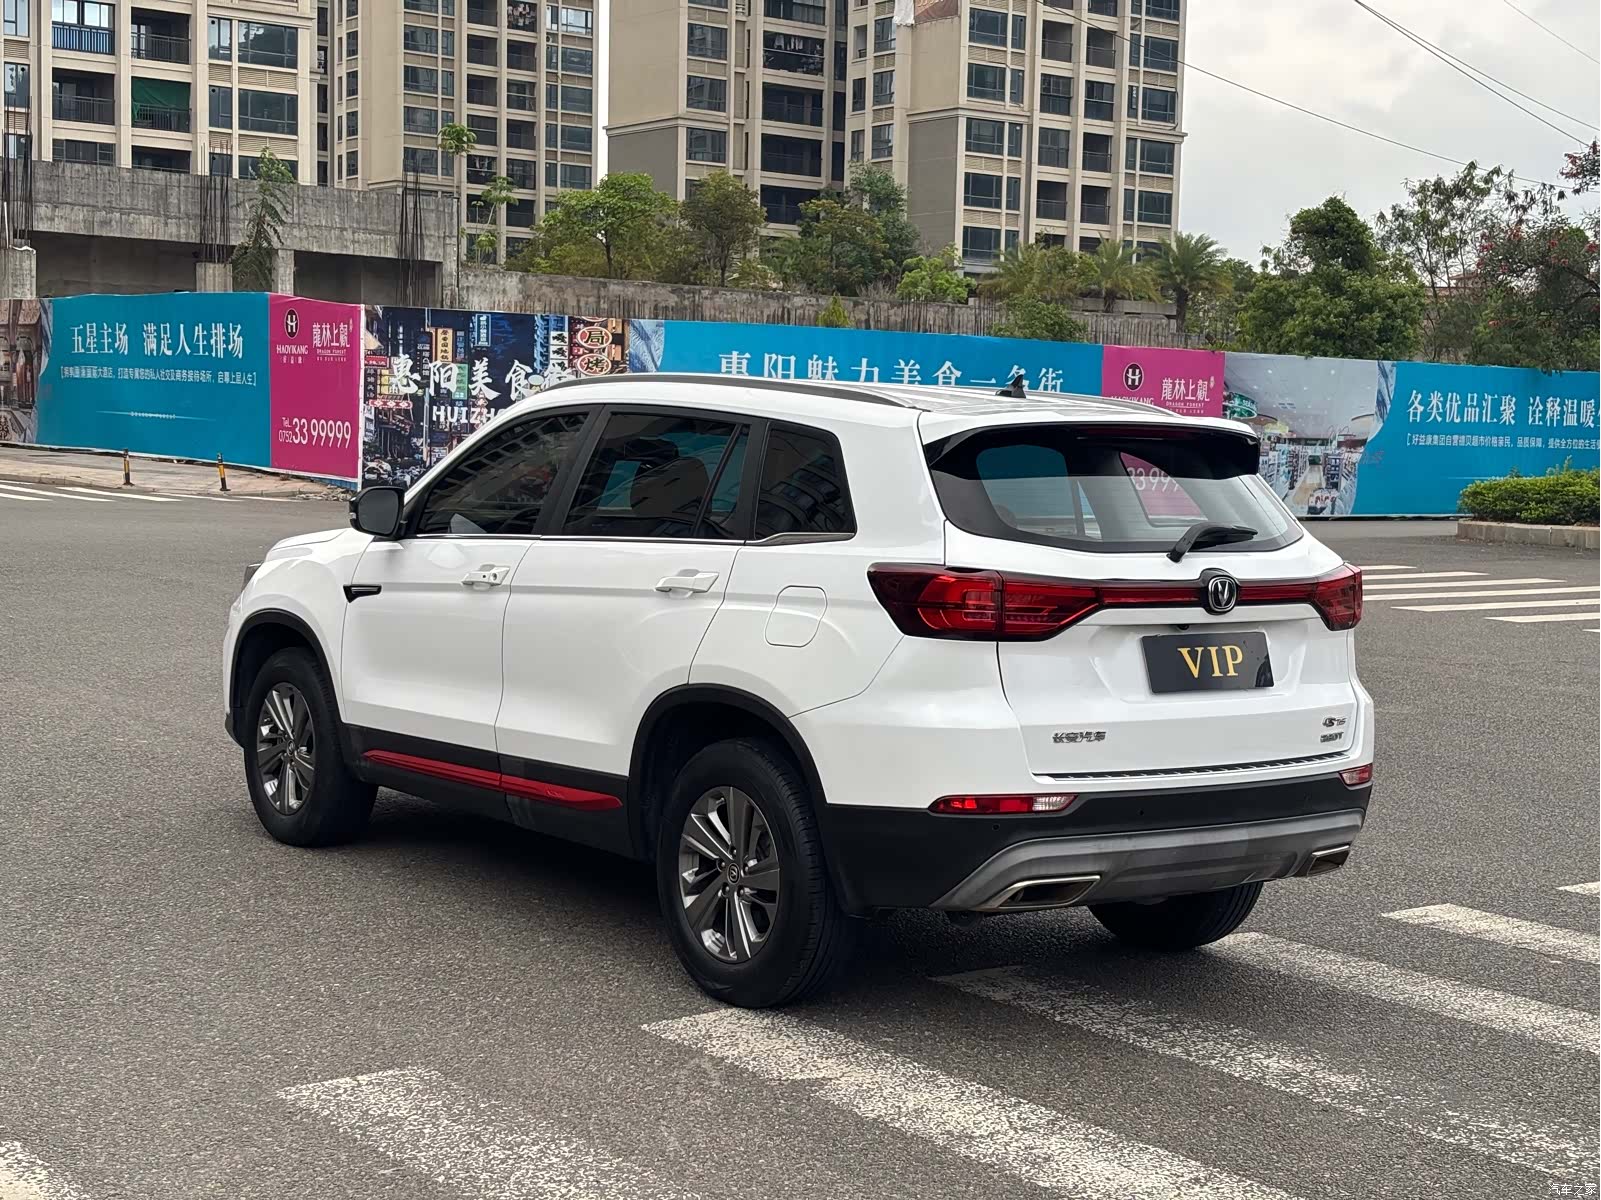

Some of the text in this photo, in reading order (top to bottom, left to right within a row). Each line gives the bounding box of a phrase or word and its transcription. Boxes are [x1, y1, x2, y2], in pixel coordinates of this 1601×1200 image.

[70, 322, 244, 359] 五星主场 满足人生排场
[276, 344, 309, 355] HAOYIKANG
[1407, 389, 1516, 426] 各类优品汇聚
[278, 417, 352, 449] 0752 33 99999
[1177, 645, 1244, 679] VIP
[1052, 731, 1107, 744] 长安汽车
